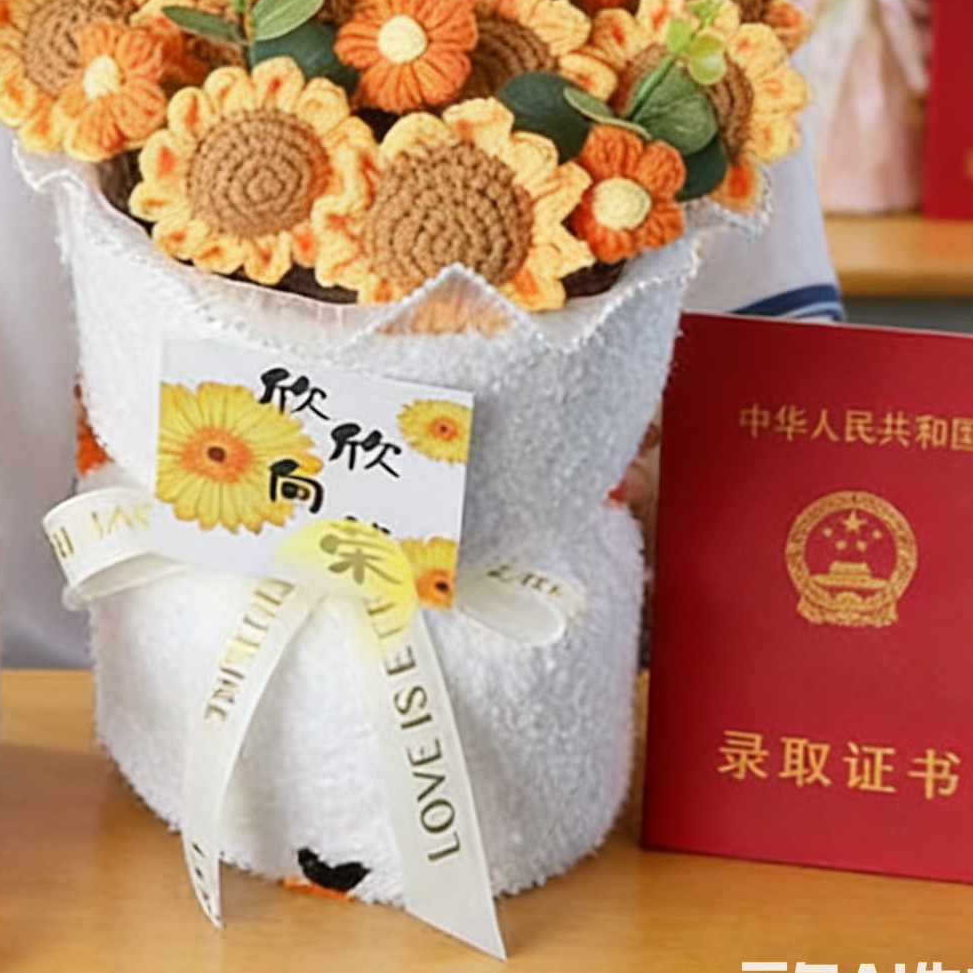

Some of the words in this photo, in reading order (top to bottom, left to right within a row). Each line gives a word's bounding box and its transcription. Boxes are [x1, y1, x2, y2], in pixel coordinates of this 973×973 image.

[393, 684, 433, 730] IS
[407, 738, 461, 862] LOVE
[717, 729, 962, 800] 录取证书
